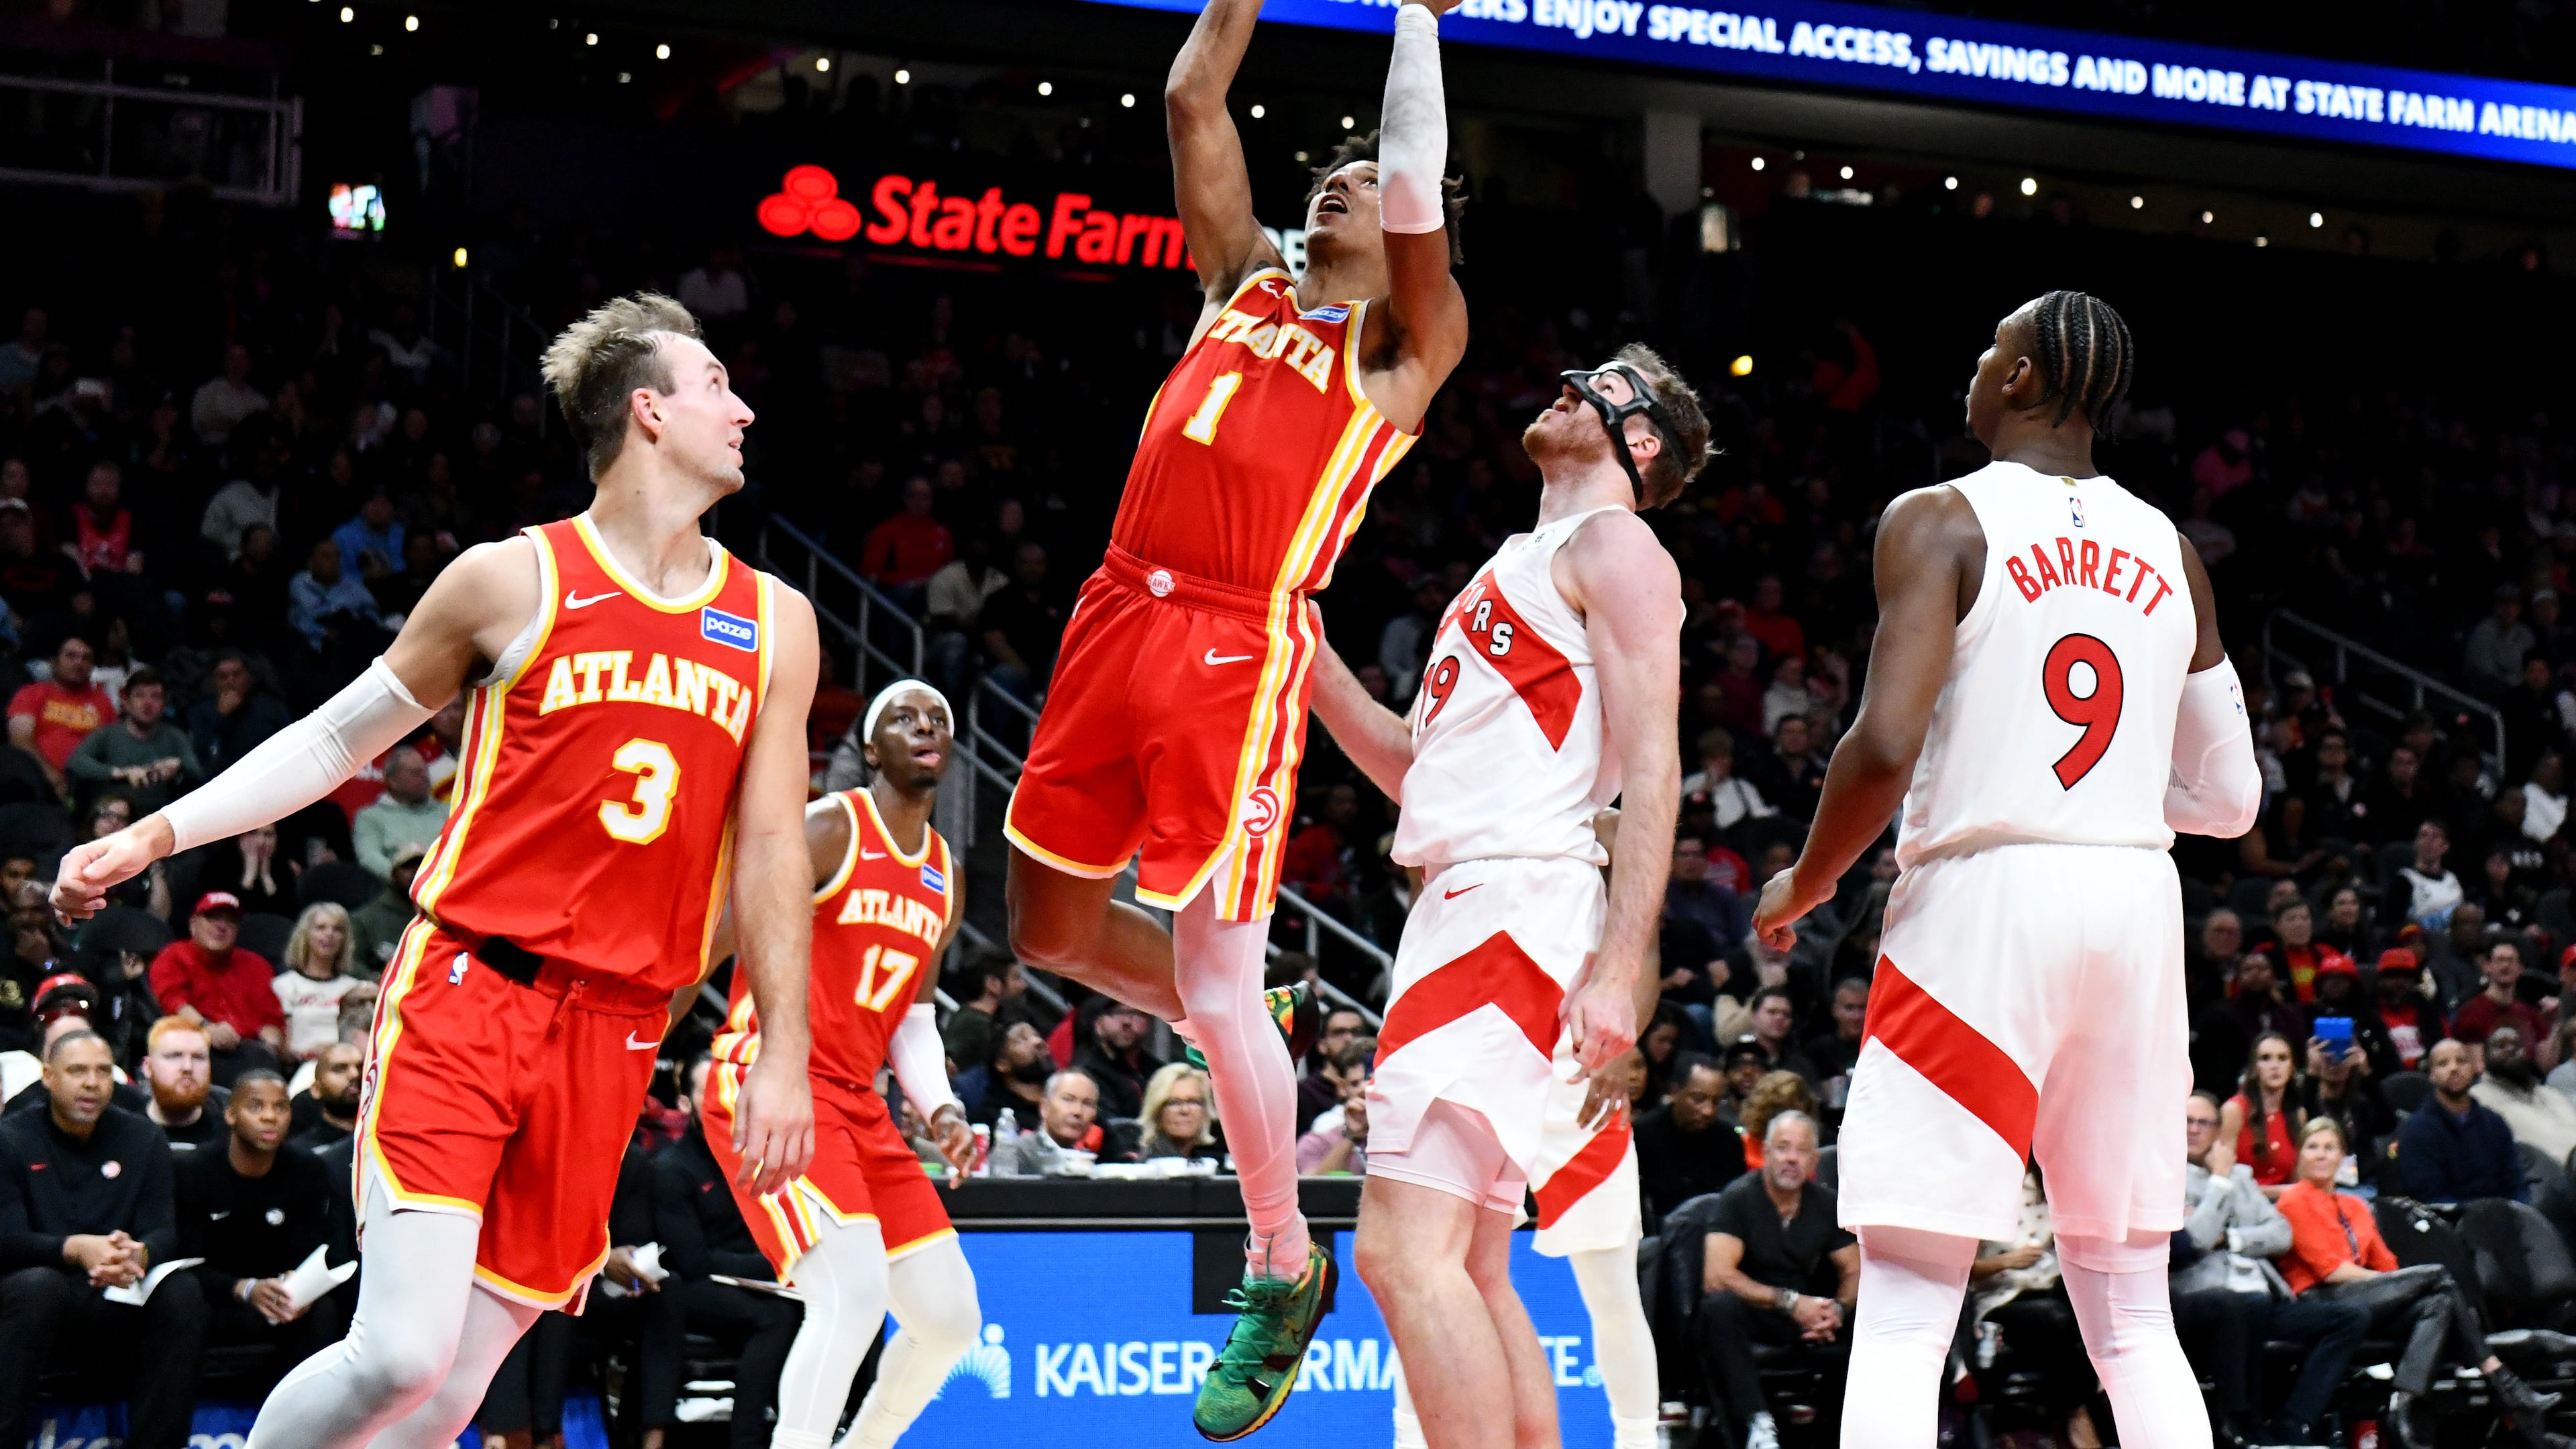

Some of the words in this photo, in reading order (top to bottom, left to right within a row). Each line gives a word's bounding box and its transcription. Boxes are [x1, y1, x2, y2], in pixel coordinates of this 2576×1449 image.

[1532, 0, 1644, 39] ENJOY
[1647, 4, 1785, 54] SPECIAL
[1788, 21, 1921, 74] ACCESS,
[1925, 36, 2070, 87] SAVINGS
[2072, 54, 2147, 95] AND
[2151, 63, 2246, 107] MORE
[2249, 74, 2292, 111] AT
[2294, 79, 2385, 123] STATE
[2388, 91, 2475, 133] FARM
[866, 174, 1040, 256] State
[1046, 193, 1197, 271] Farm
[1182, 370, 1243, 446] 1
[2006, 537, 2173, 616] BARRETT
[706, 616, 753, 641] paze
[539, 650, 753, 747] ATLANTA
[1417, 655, 1460, 738] 19
[2043, 633, 2124, 791] 9
[598, 738, 681, 845] 3
[855, 944, 919, 1013] 17
[1036, 1342, 1216, 1397] KAISER
